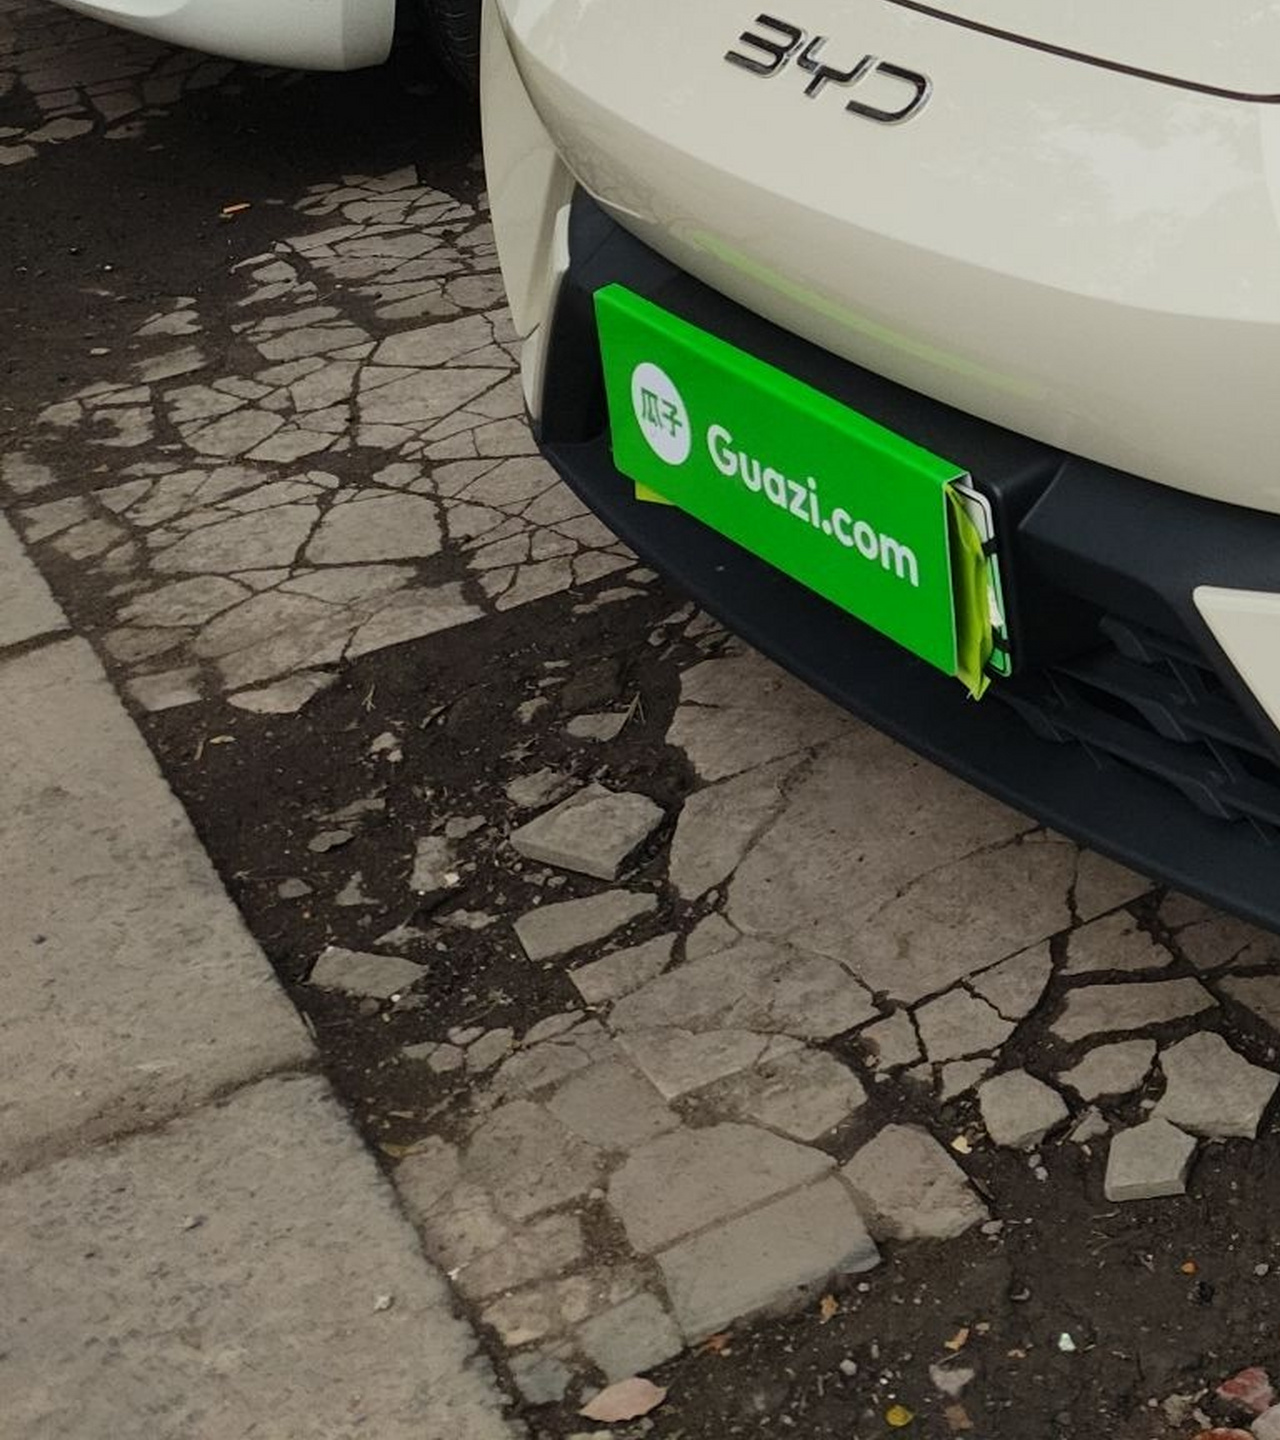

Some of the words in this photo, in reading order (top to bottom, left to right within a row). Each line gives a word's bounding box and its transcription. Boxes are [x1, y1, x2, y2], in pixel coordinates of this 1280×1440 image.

[724, 13, 933, 126] BYD
[641, 386, 683, 439] 瓜子
[707, 424, 919, 588] Guazi.com
